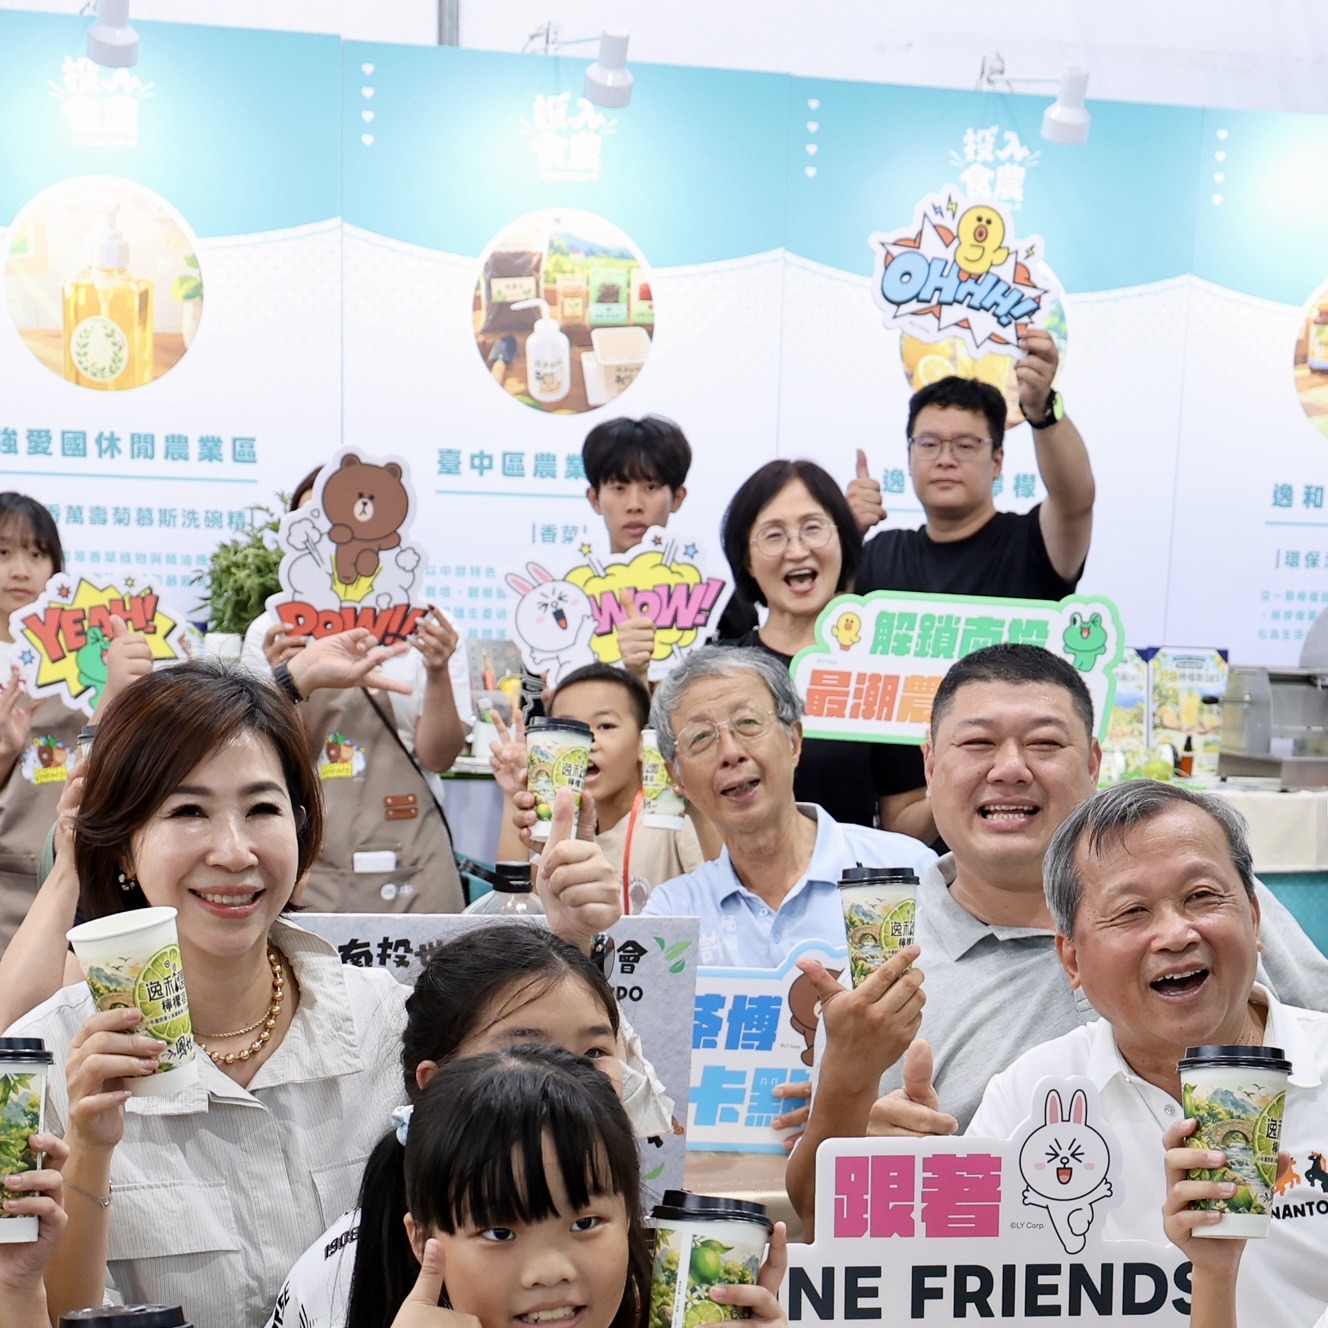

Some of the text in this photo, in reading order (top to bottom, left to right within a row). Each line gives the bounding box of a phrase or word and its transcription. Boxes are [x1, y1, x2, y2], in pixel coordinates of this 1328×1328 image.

[22, 594, 159, 663] YEAH!
[833, 1154, 1002, 1239] 跟著
[911, 1262, 1194, 1320] FRIENDS
